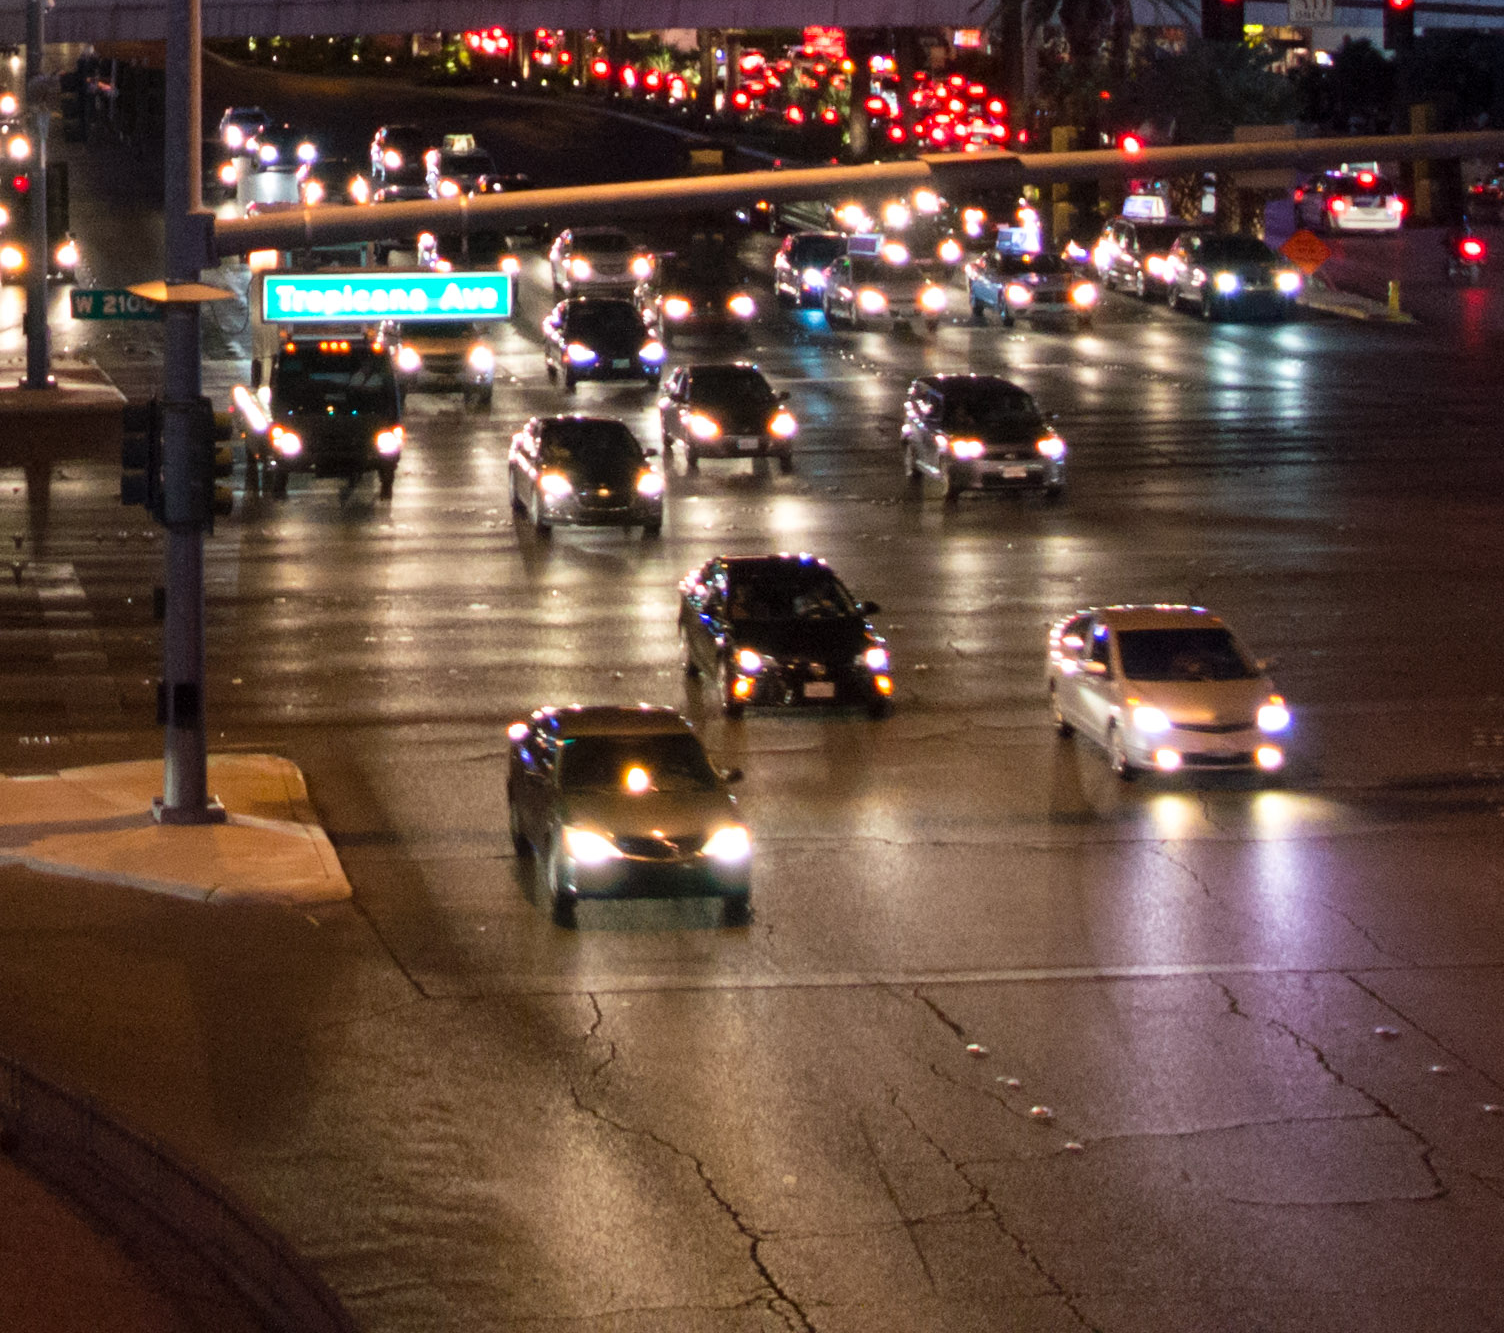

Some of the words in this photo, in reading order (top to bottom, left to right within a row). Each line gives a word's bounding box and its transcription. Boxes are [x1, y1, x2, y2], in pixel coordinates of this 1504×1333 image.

[75, 296, 93, 314] W
[275, 285, 427, 317] Tropicana
[440, 284, 498, 311] Ave
